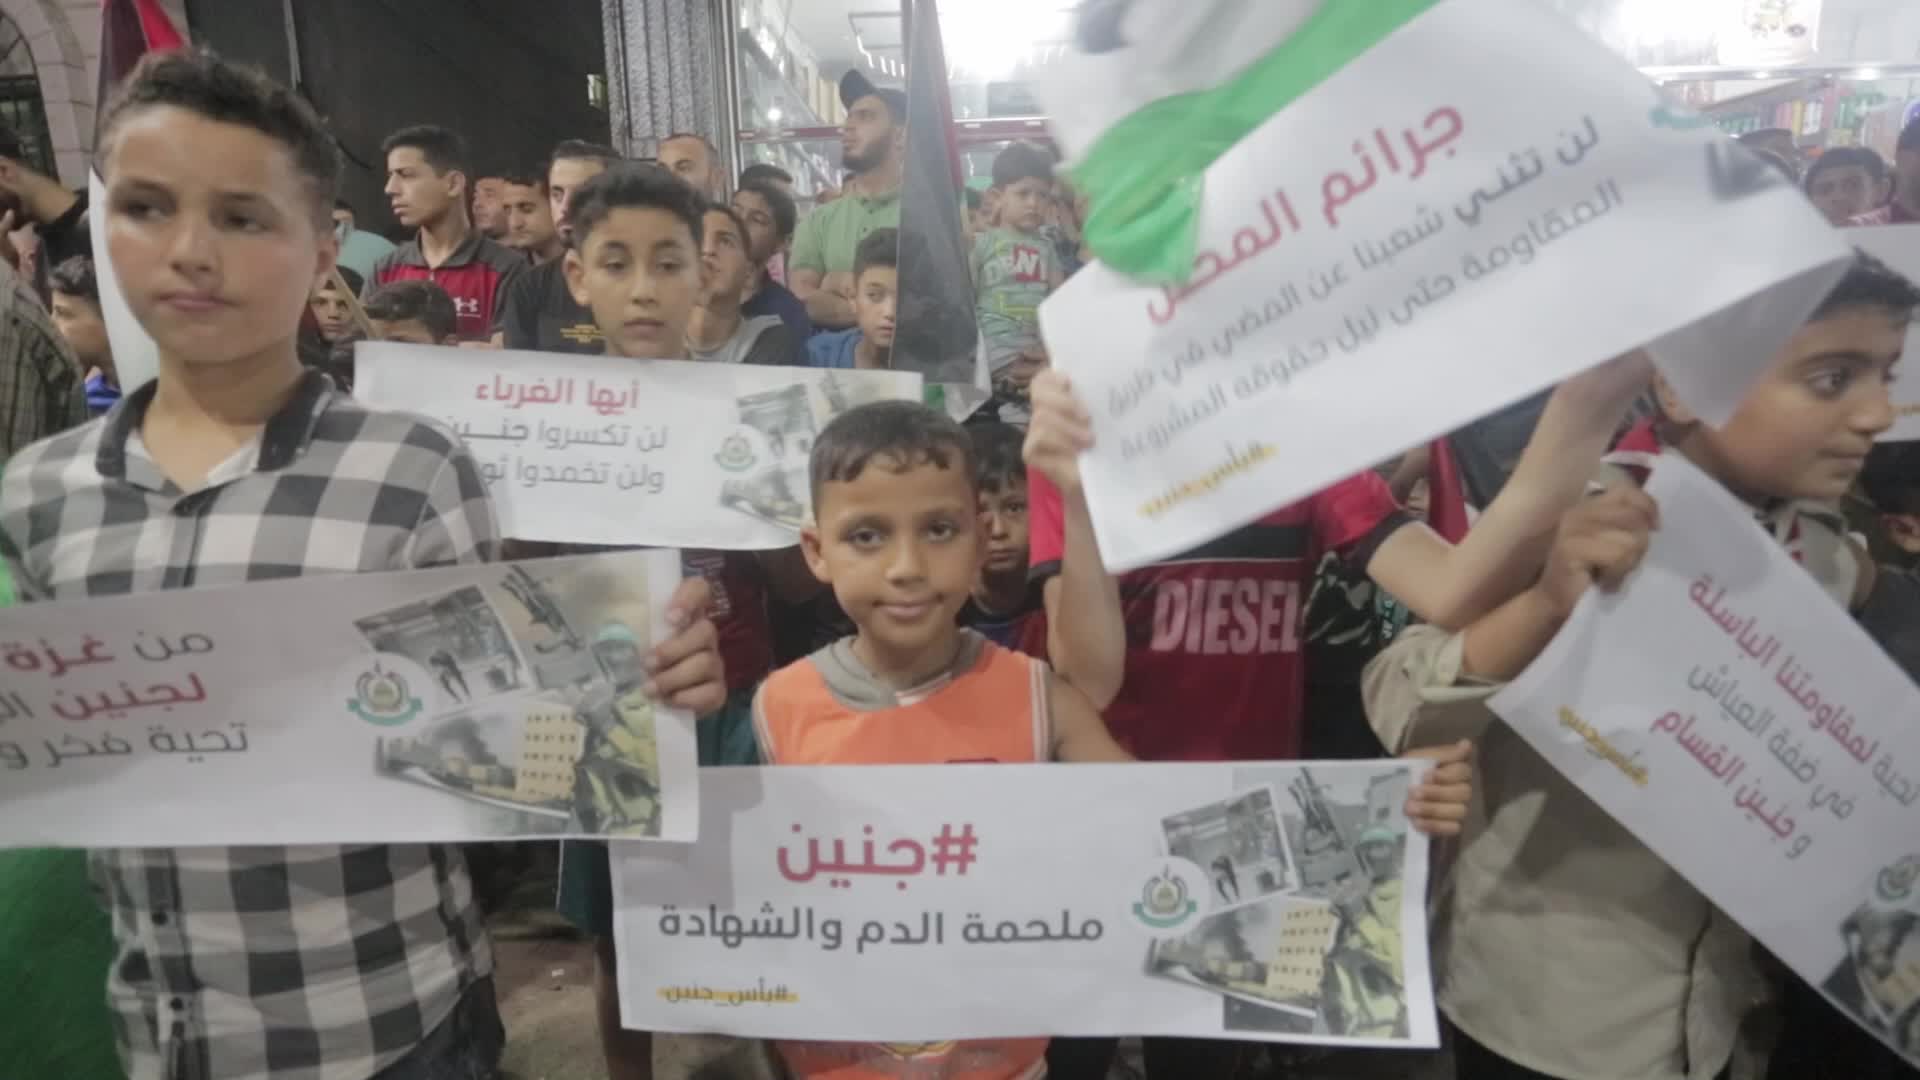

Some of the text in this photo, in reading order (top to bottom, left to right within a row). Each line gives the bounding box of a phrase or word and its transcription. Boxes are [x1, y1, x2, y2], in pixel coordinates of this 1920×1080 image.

[1555, 114, 1600, 167] لن
[1146, 106, 1464, 326] جرائم المحل
[1461, 177, 1625, 281] المقاومة
[474, 373, 641, 416] أيها الغرباء
[536, 419, 633, 450] تكسروا
[636, 424, 669, 453] لن
[515, 455, 612, 489] تخمدوا
[615, 462, 666, 495] ولن
[1150, 577, 1300, 656] DIESEL
[1688, 573, 1783, 668] الباسلة
[1, 630, 214, 677] من غزة
[51, 671, 207, 720] لجنين
[43, 731, 133, 768] فخر
[149, 721, 248, 763] تحية
[1649, 709, 1747, 787] القسام
[776, 823, 979, 890] #جنين
[658, 900, 1105, 954] ملحمة الدم والشهادة
